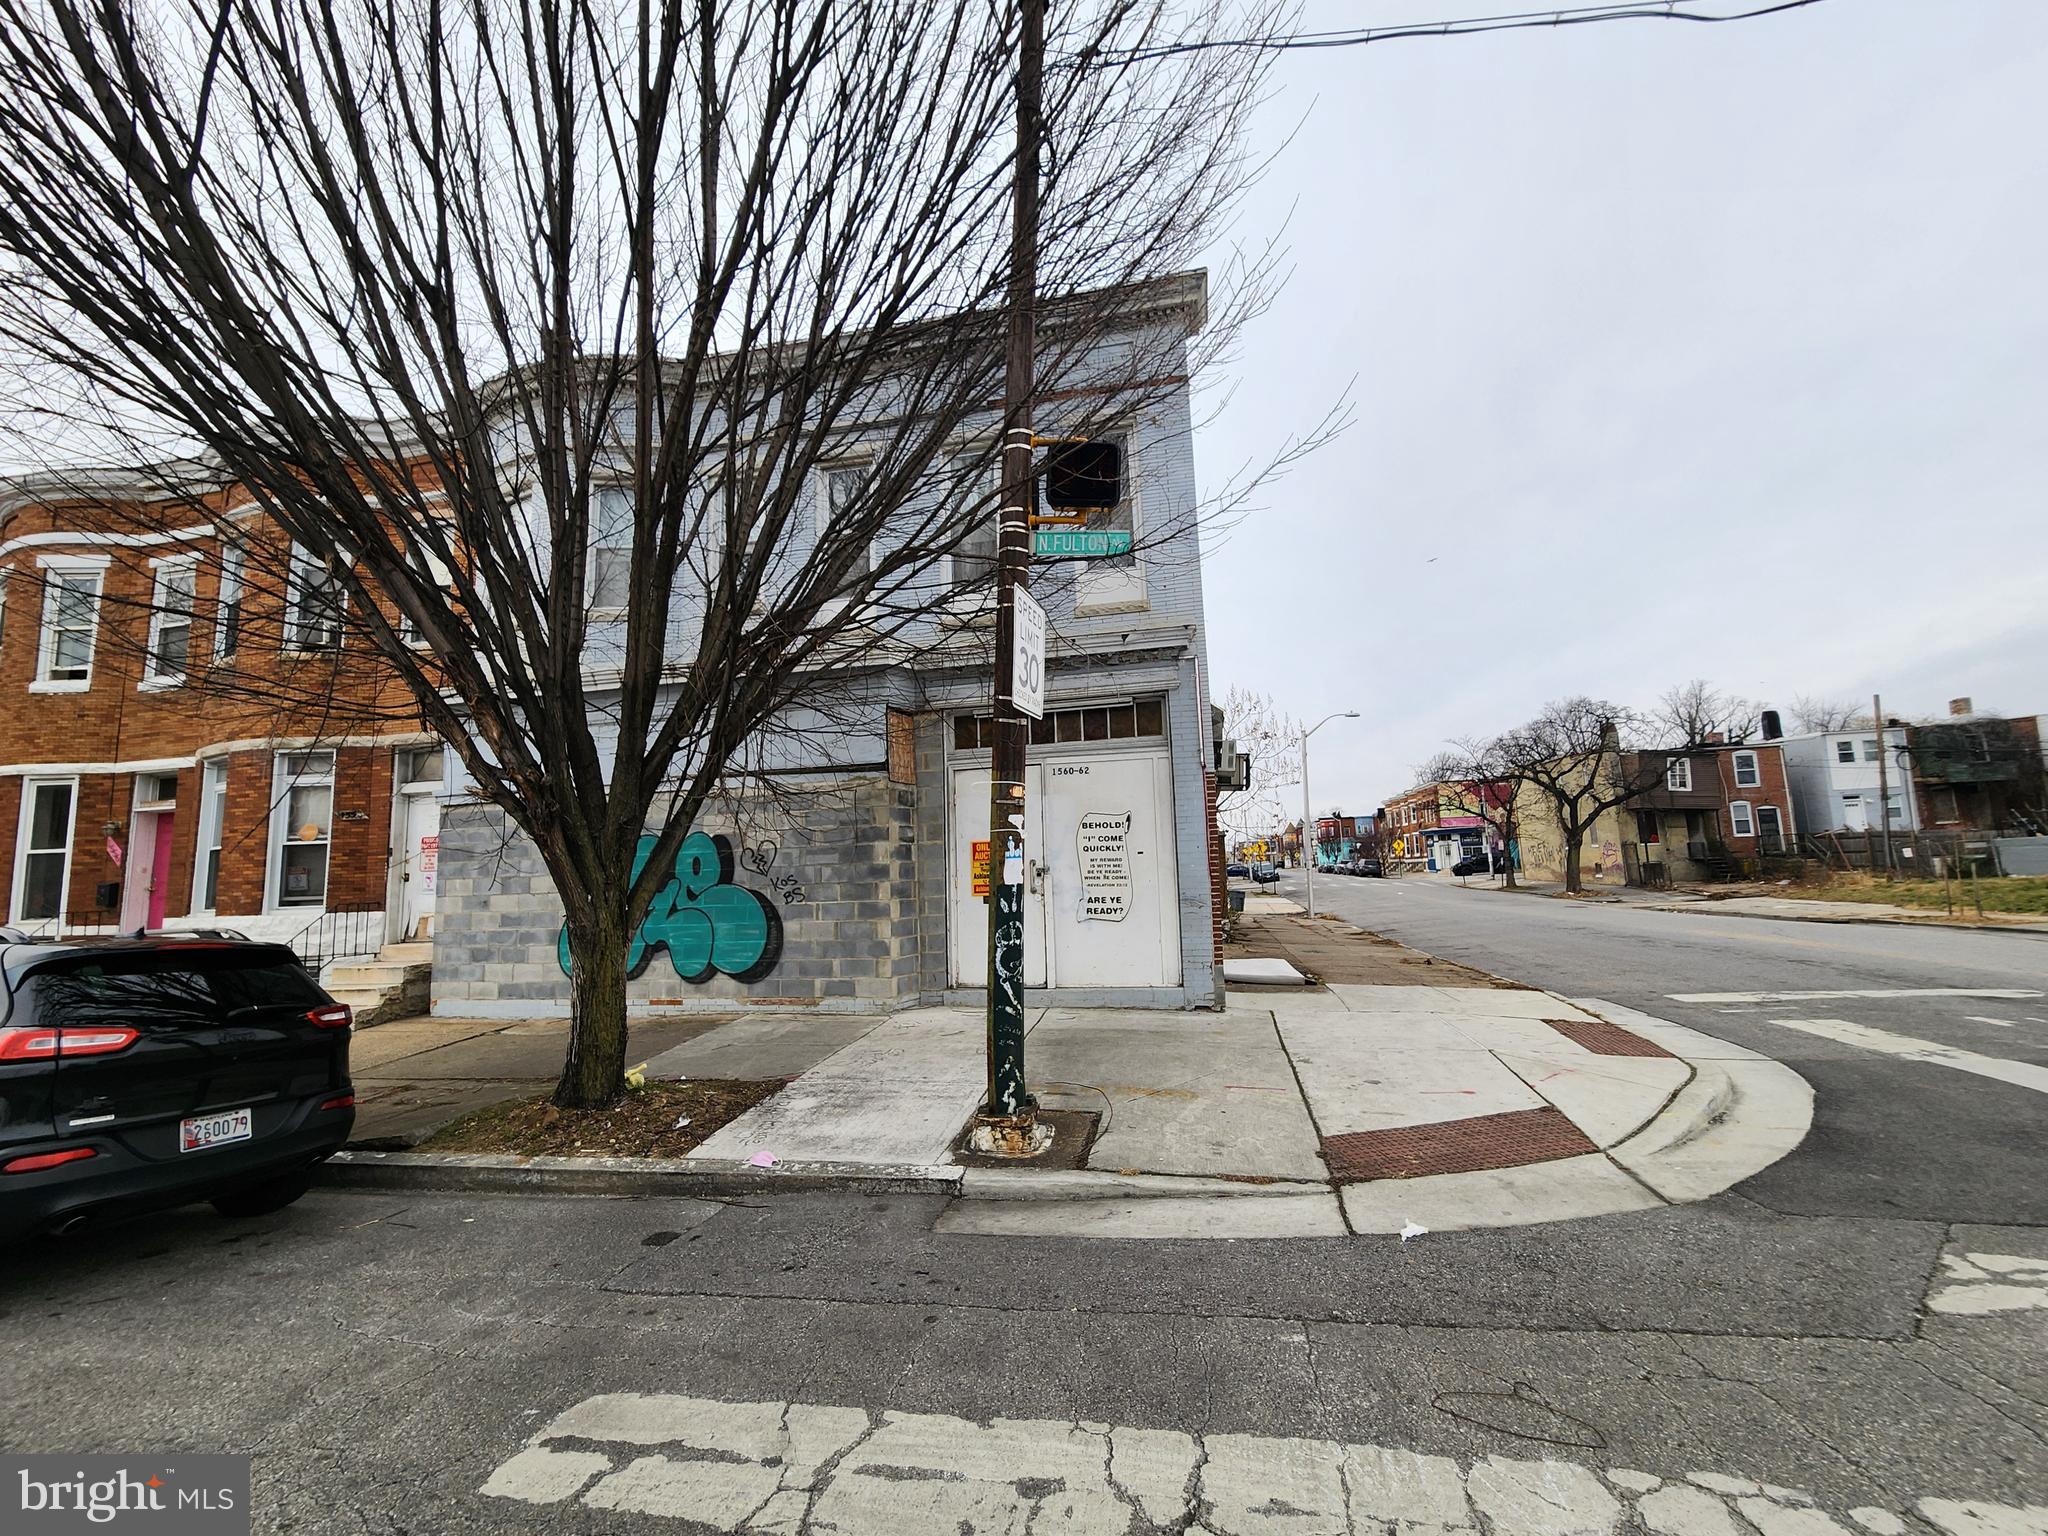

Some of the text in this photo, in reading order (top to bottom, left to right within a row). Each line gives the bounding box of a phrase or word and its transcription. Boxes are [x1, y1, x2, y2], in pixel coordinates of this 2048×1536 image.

[1017, 597, 1042, 630] SPEED
[1019, 621, 1040, 652] LIMIT
[1018, 646, 1039, 694] 30
[1052, 766, 1090, 776] 1560-62
[1081, 821, 1125, 829] BEHOLD!
[1087, 896, 1122, 904] ARE YE
[1086, 907, 1124, 915] READY?
